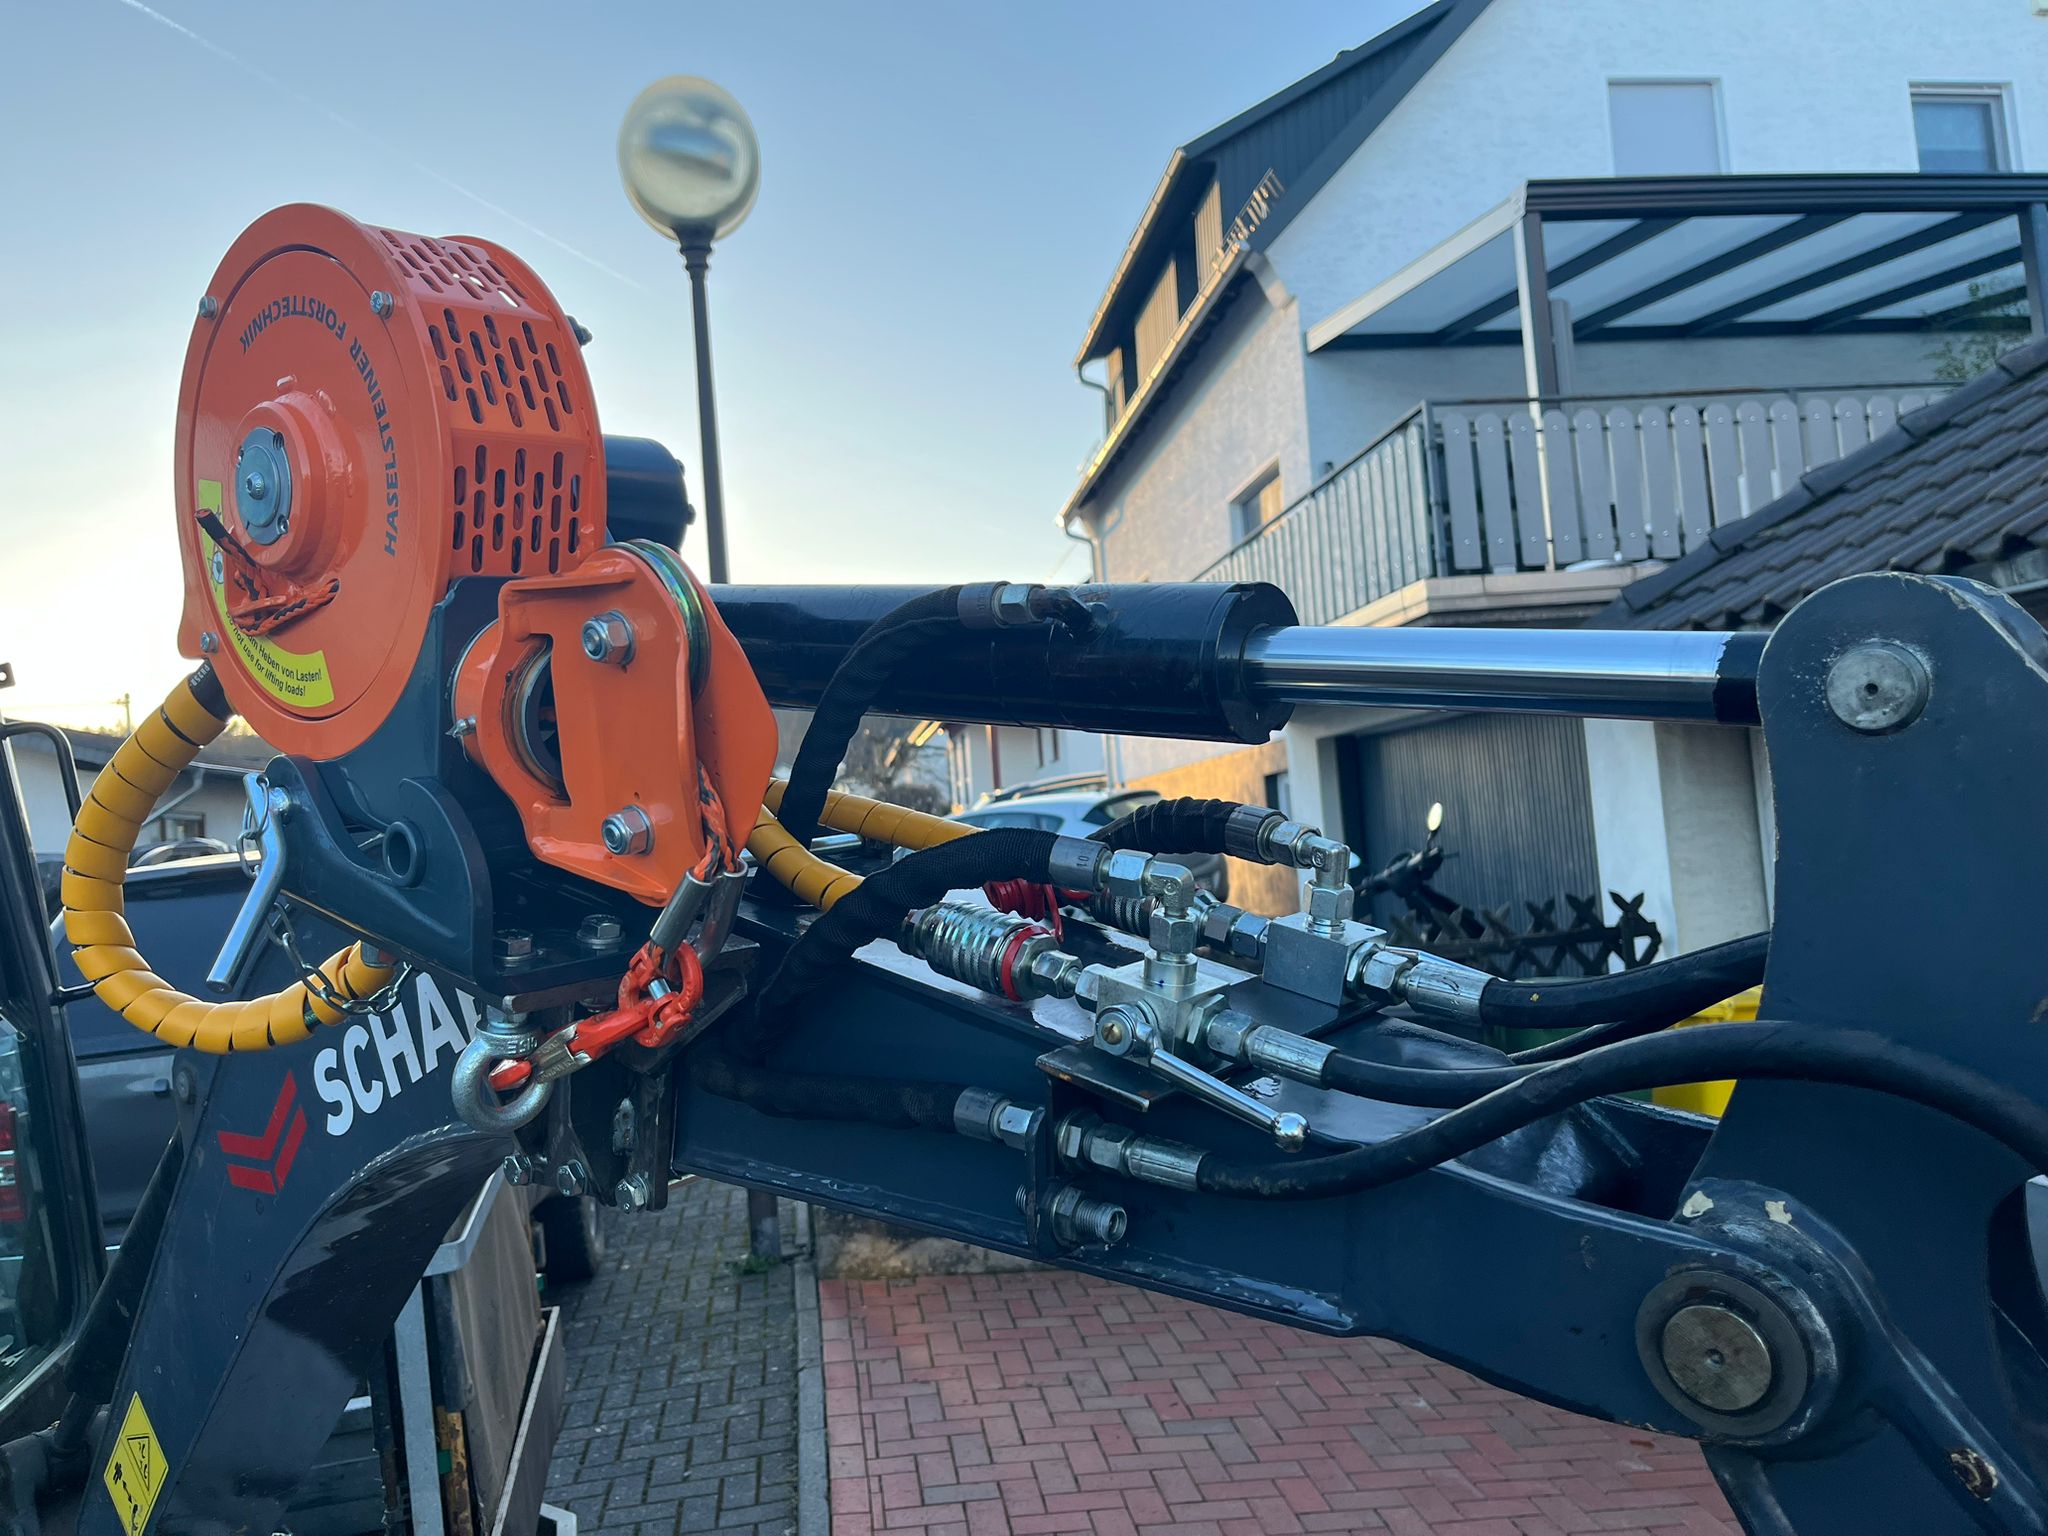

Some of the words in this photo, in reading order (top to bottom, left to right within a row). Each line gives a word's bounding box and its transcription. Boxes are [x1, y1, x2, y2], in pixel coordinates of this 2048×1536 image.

[239, 295, 347, 354] FORSTTECHNIK
[349, 336, 400, 557] HASELSTEINER
[243, 644, 255, 662] use
[254, 658, 265, 673] for
[264, 668, 284, 692] lifting
[285, 681, 306, 697] loads!
[259, 645, 280, 671] Heben
[281, 665, 294, 679] von
[296, 668, 322, 682] Lasten!
